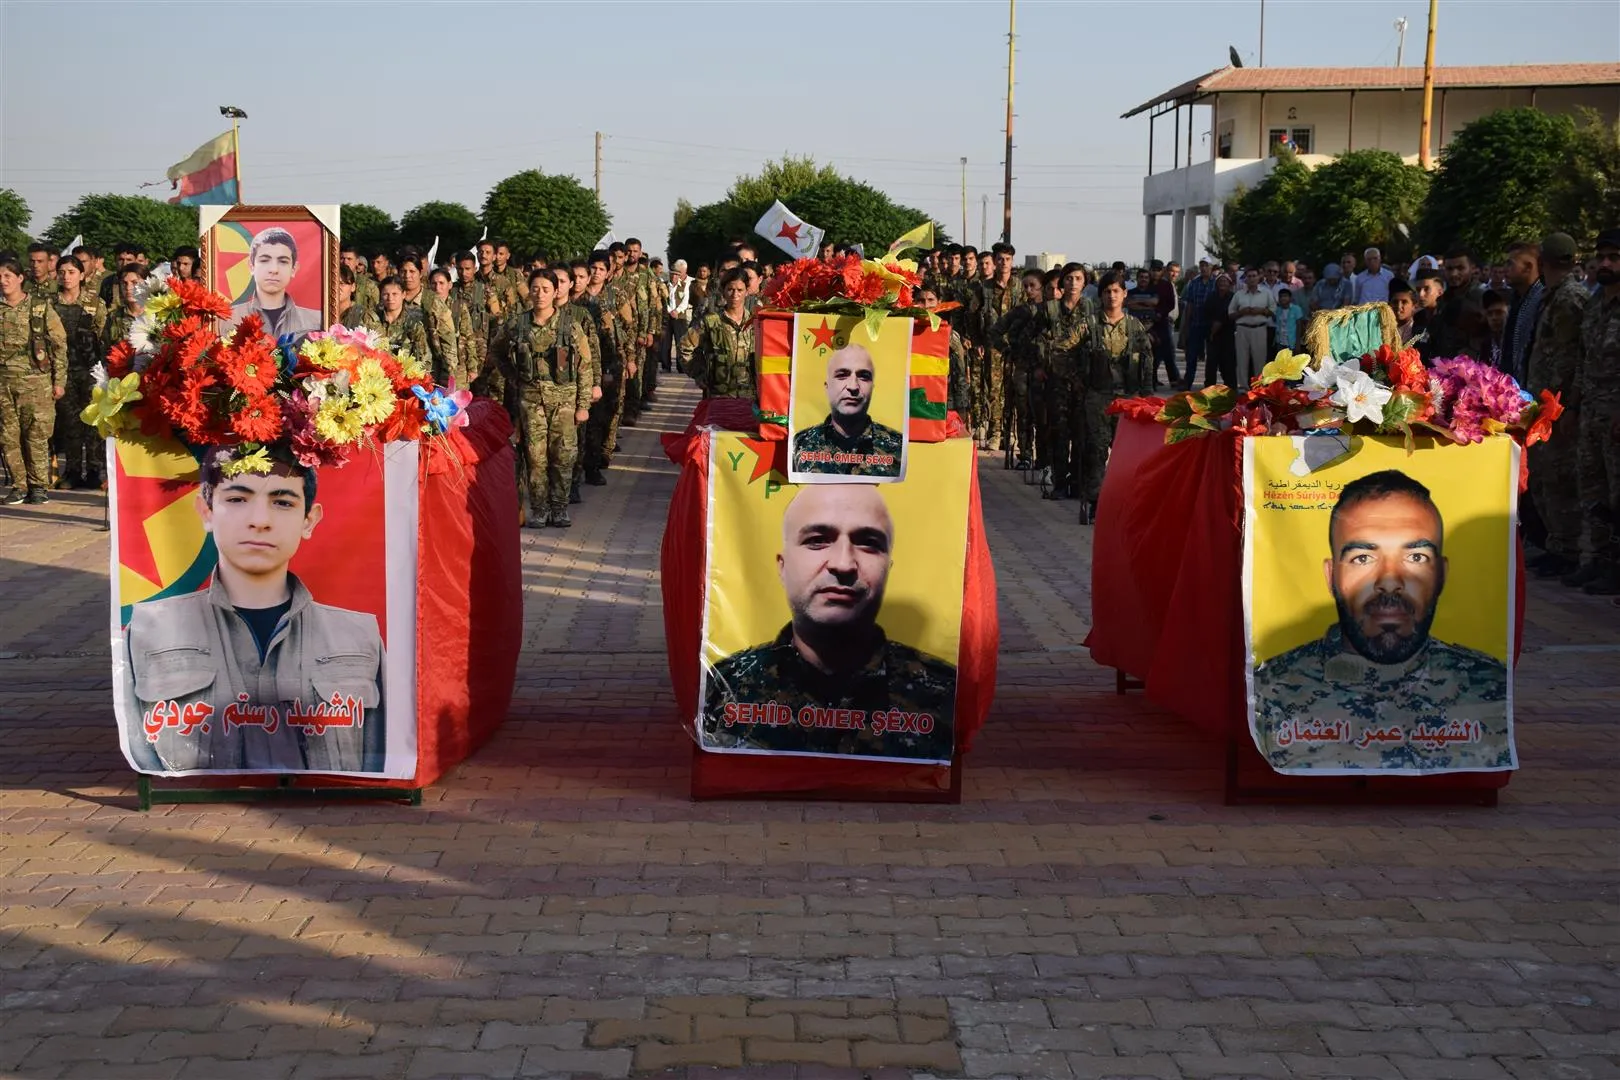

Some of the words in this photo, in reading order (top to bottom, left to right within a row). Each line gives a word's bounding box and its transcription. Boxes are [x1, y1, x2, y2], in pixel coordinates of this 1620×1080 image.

[803, 334, 811, 345] Y
[835, 336, 845, 347] G
[819, 347, 827, 358] P
[727, 451, 745, 472] Y
[834, 452, 864, 464] OMER
[765, 480, 782, 499] P
[143, 698, 214, 743] جودي
[222, 692, 279, 736] رستم
[286, 691, 364, 735] الشهيد
[798, 705, 866, 730] OMER
[871, 707, 935, 736] ŞÊXO
[1277, 718, 1350, 748] العثمان
[1354, 724, 1402, 749] عمر
[1411, 718, 1481, 749] الشهيد
